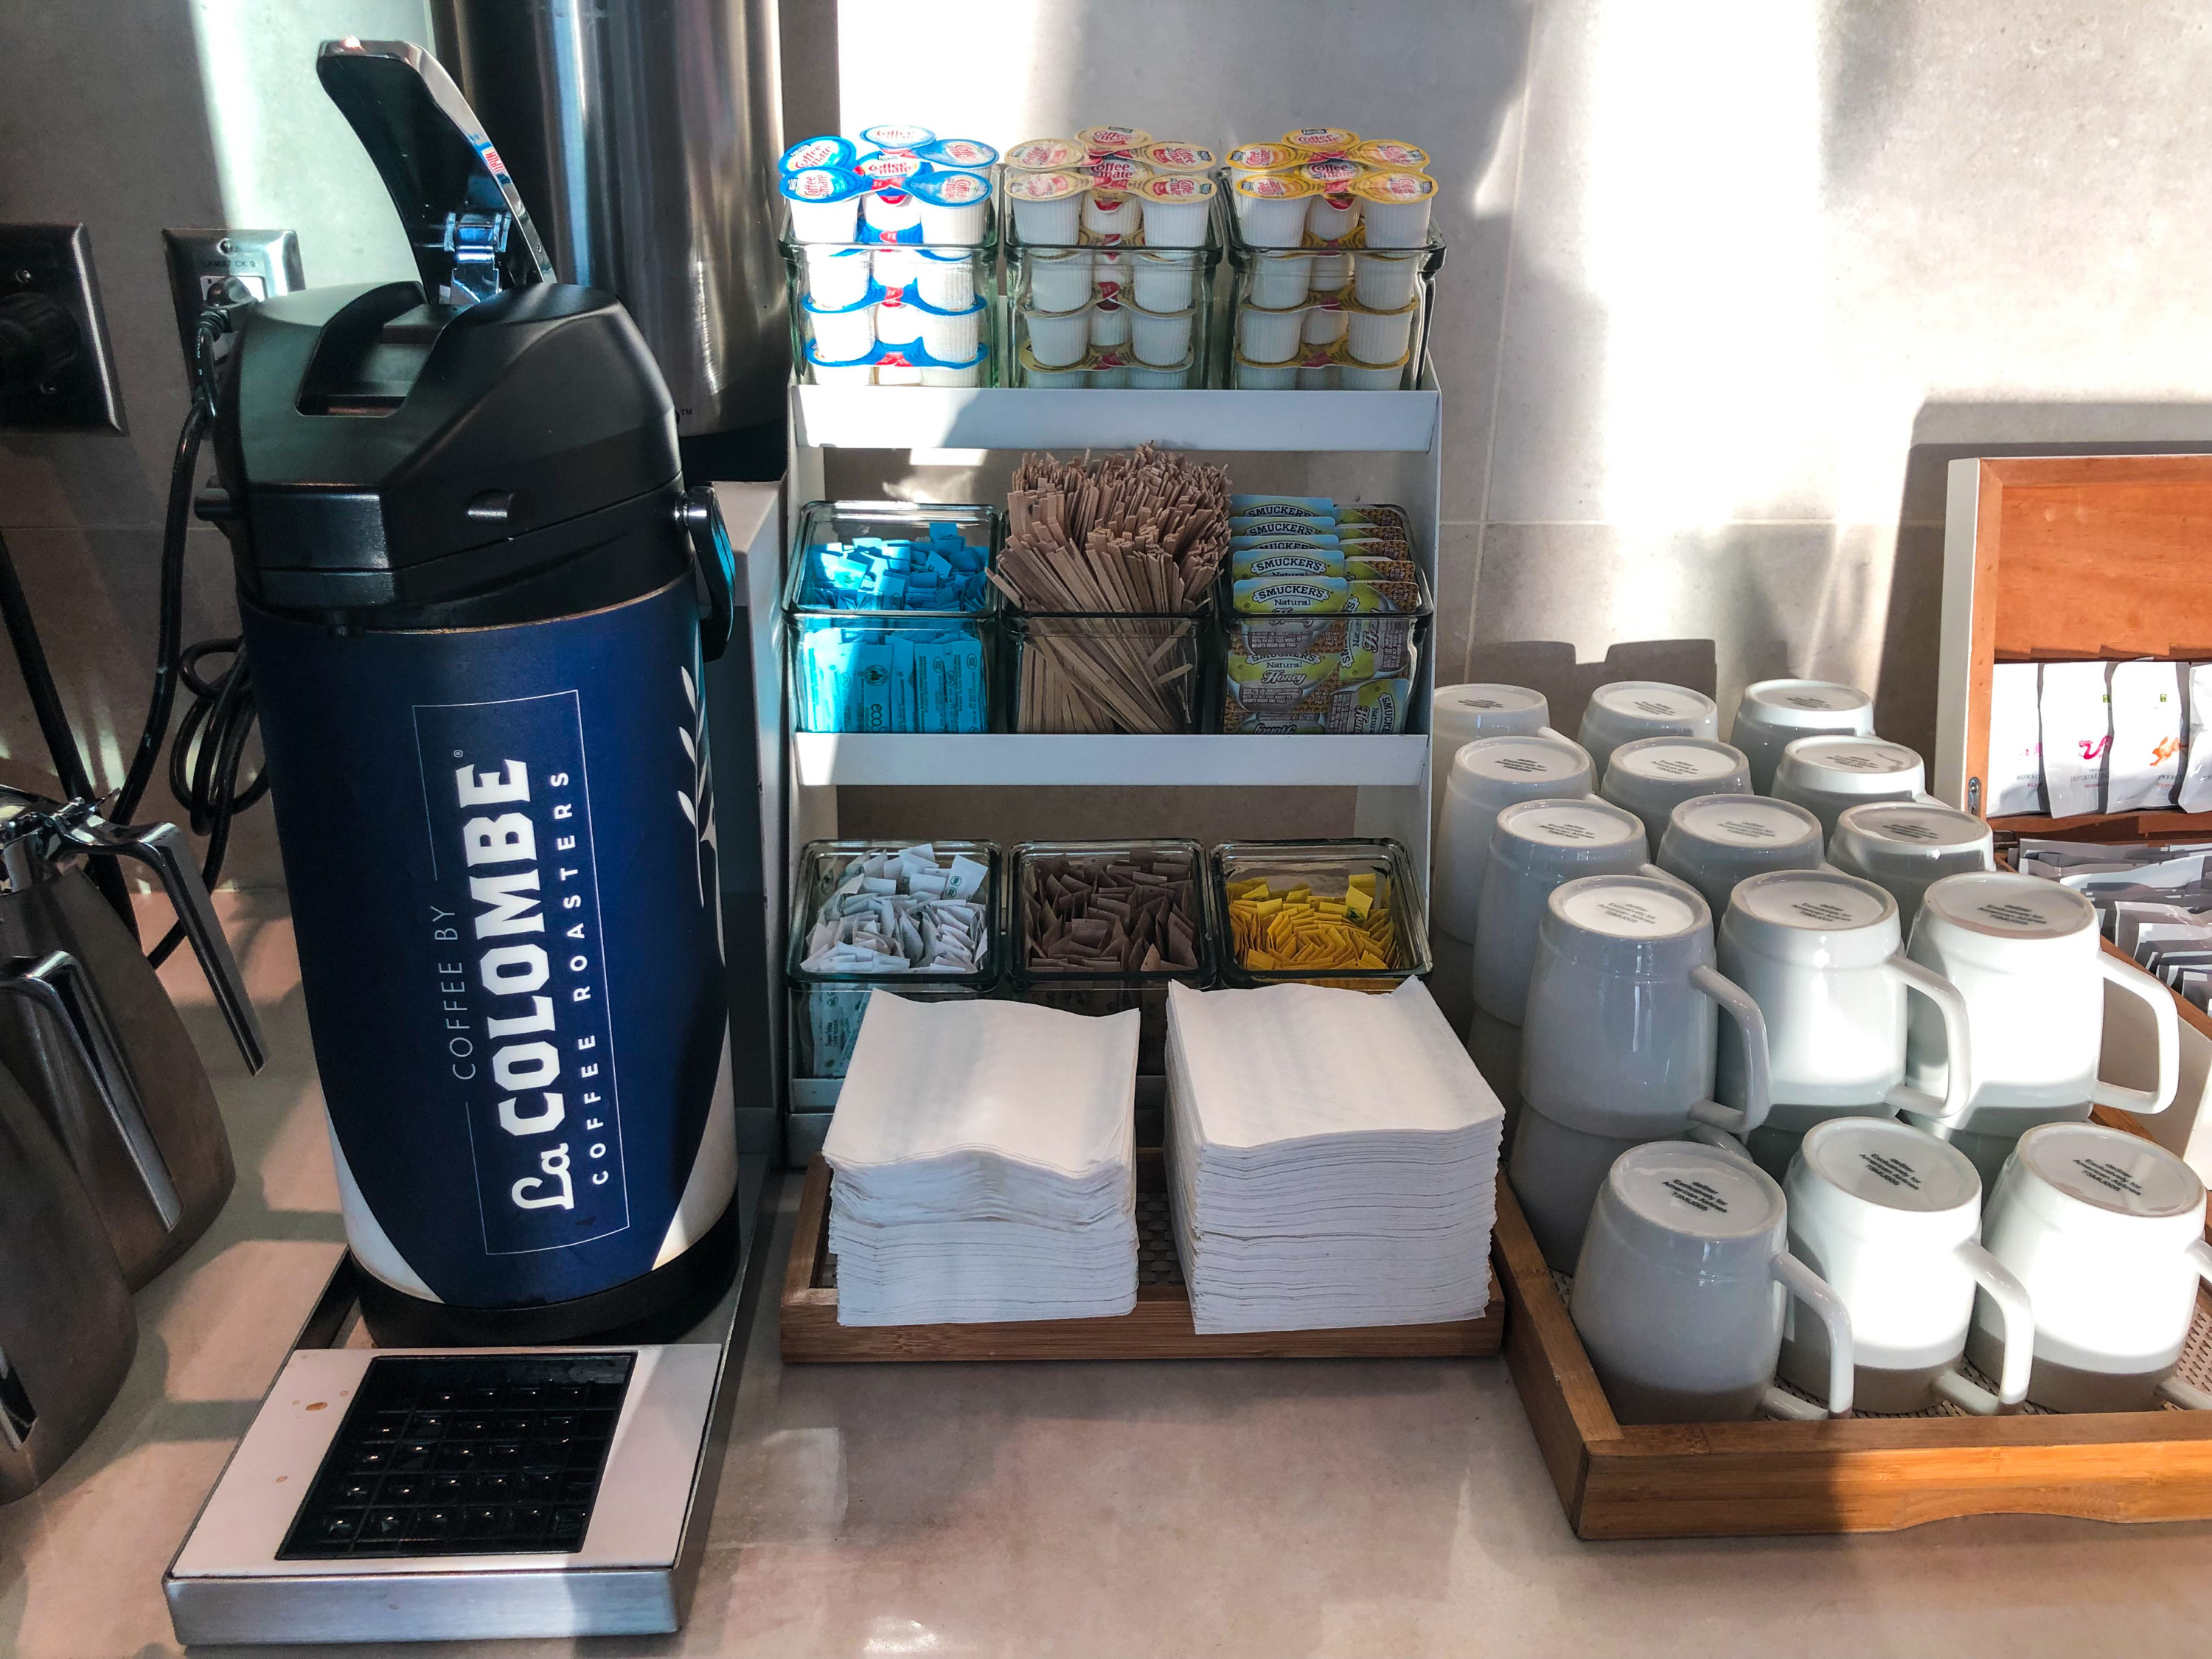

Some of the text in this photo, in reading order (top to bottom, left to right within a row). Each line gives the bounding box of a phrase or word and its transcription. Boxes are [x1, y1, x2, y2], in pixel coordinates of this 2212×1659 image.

[869, 162, 907, 172] Coffee
[1091, 162, 1130, 173] Coffee
[1250, 523, 1313, 536] SMUCKER'S
[1256, 557, 1322, 571] SMUCKER'S
[1259, 585, 1325, 599] SMUCKER'S
[1261, 670, 1307, 685] Honey
[455, 758, 574, 1211] La COLOMBE
[550, 771, 608, 1185] COFFEE ROASTERS
[431, 905, 476, 1081] COFFEE BY
[1859, 1154, 1920, 1190] American Airlines
[1871, 1153, 1910, 1177] Exclusively
[2073, 1159, 2140, 1195] American Airlines
[2085, 1158, 2129, 1182] Exclusively
[1662, 1181, 1727, 1213] American Airlines
[1674, 1179, 1715, 1200] Exclusively
